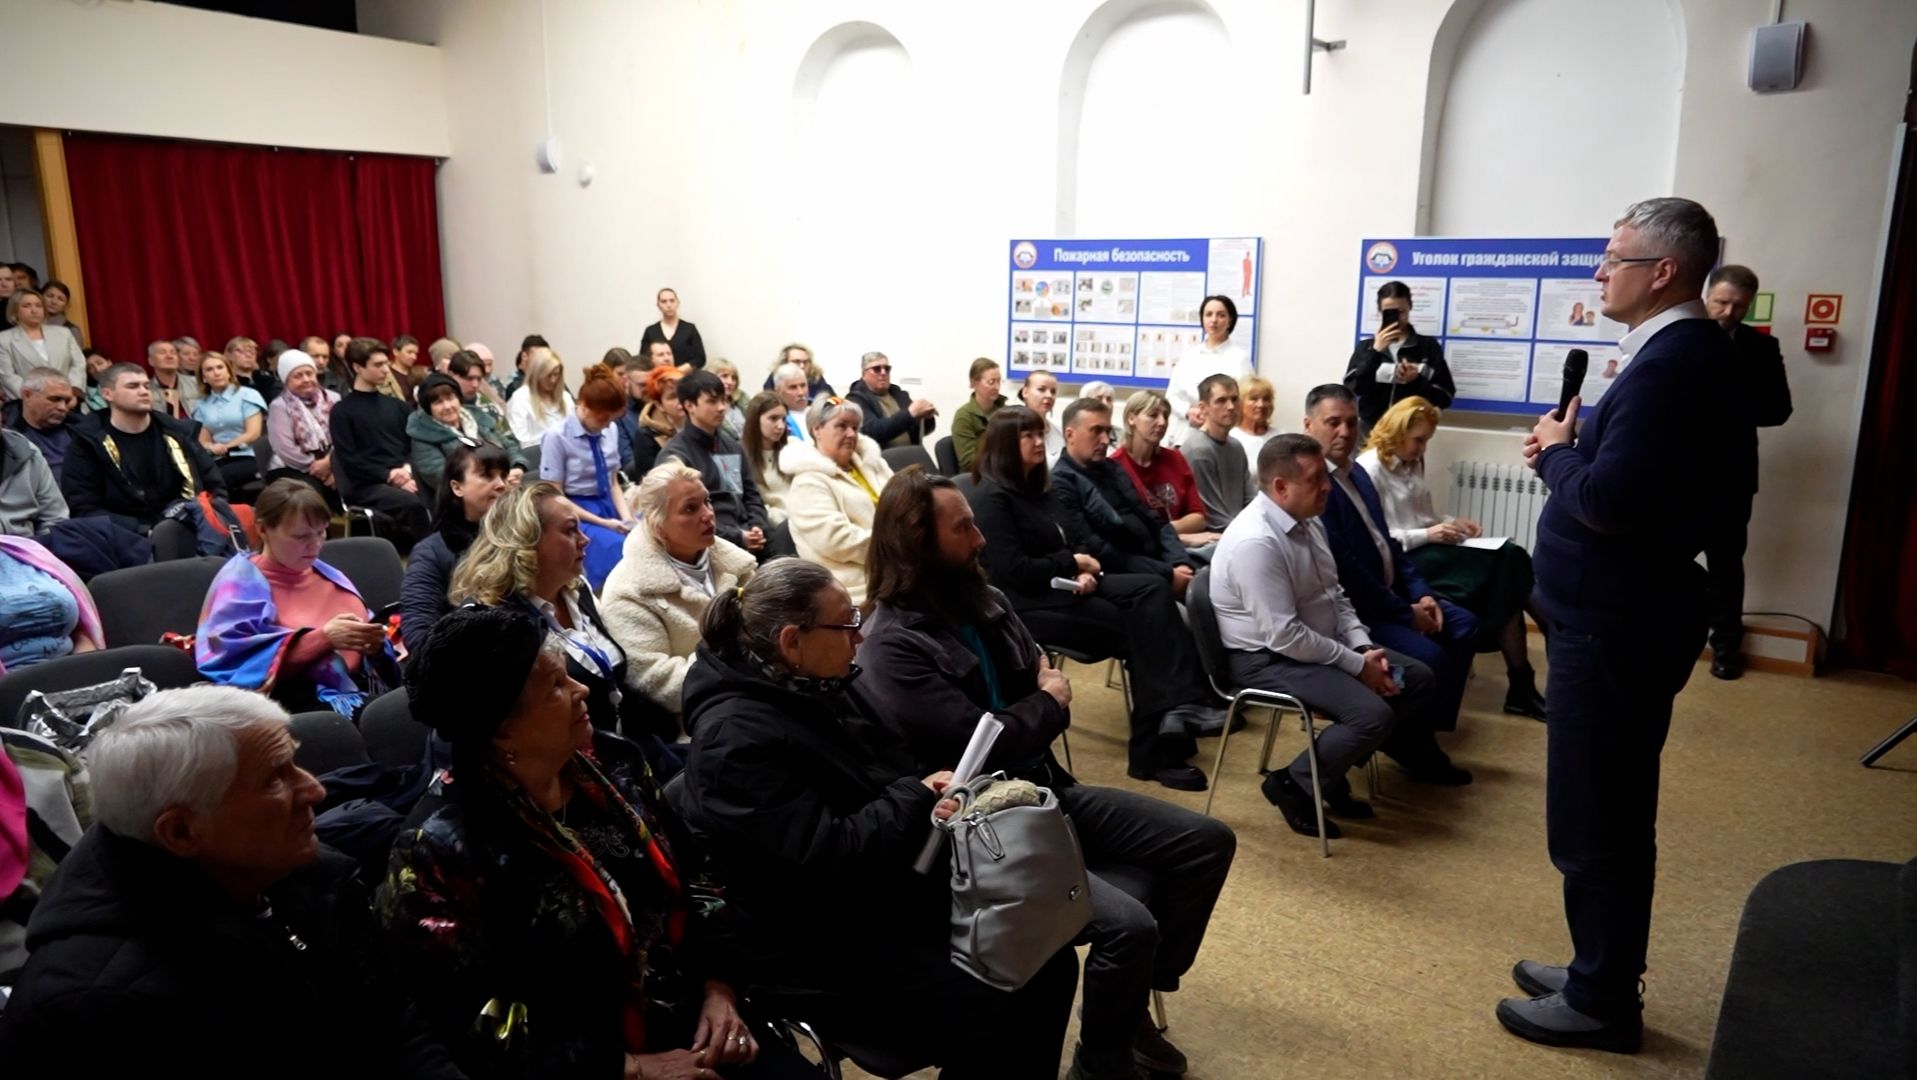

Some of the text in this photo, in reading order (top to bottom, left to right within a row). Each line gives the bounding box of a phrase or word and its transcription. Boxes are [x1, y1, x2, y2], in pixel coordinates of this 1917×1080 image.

[1053, 248, 1190, 265] Пожарная безопасность
[1412, 251, 1606, 268] Уголок гражданской защи
